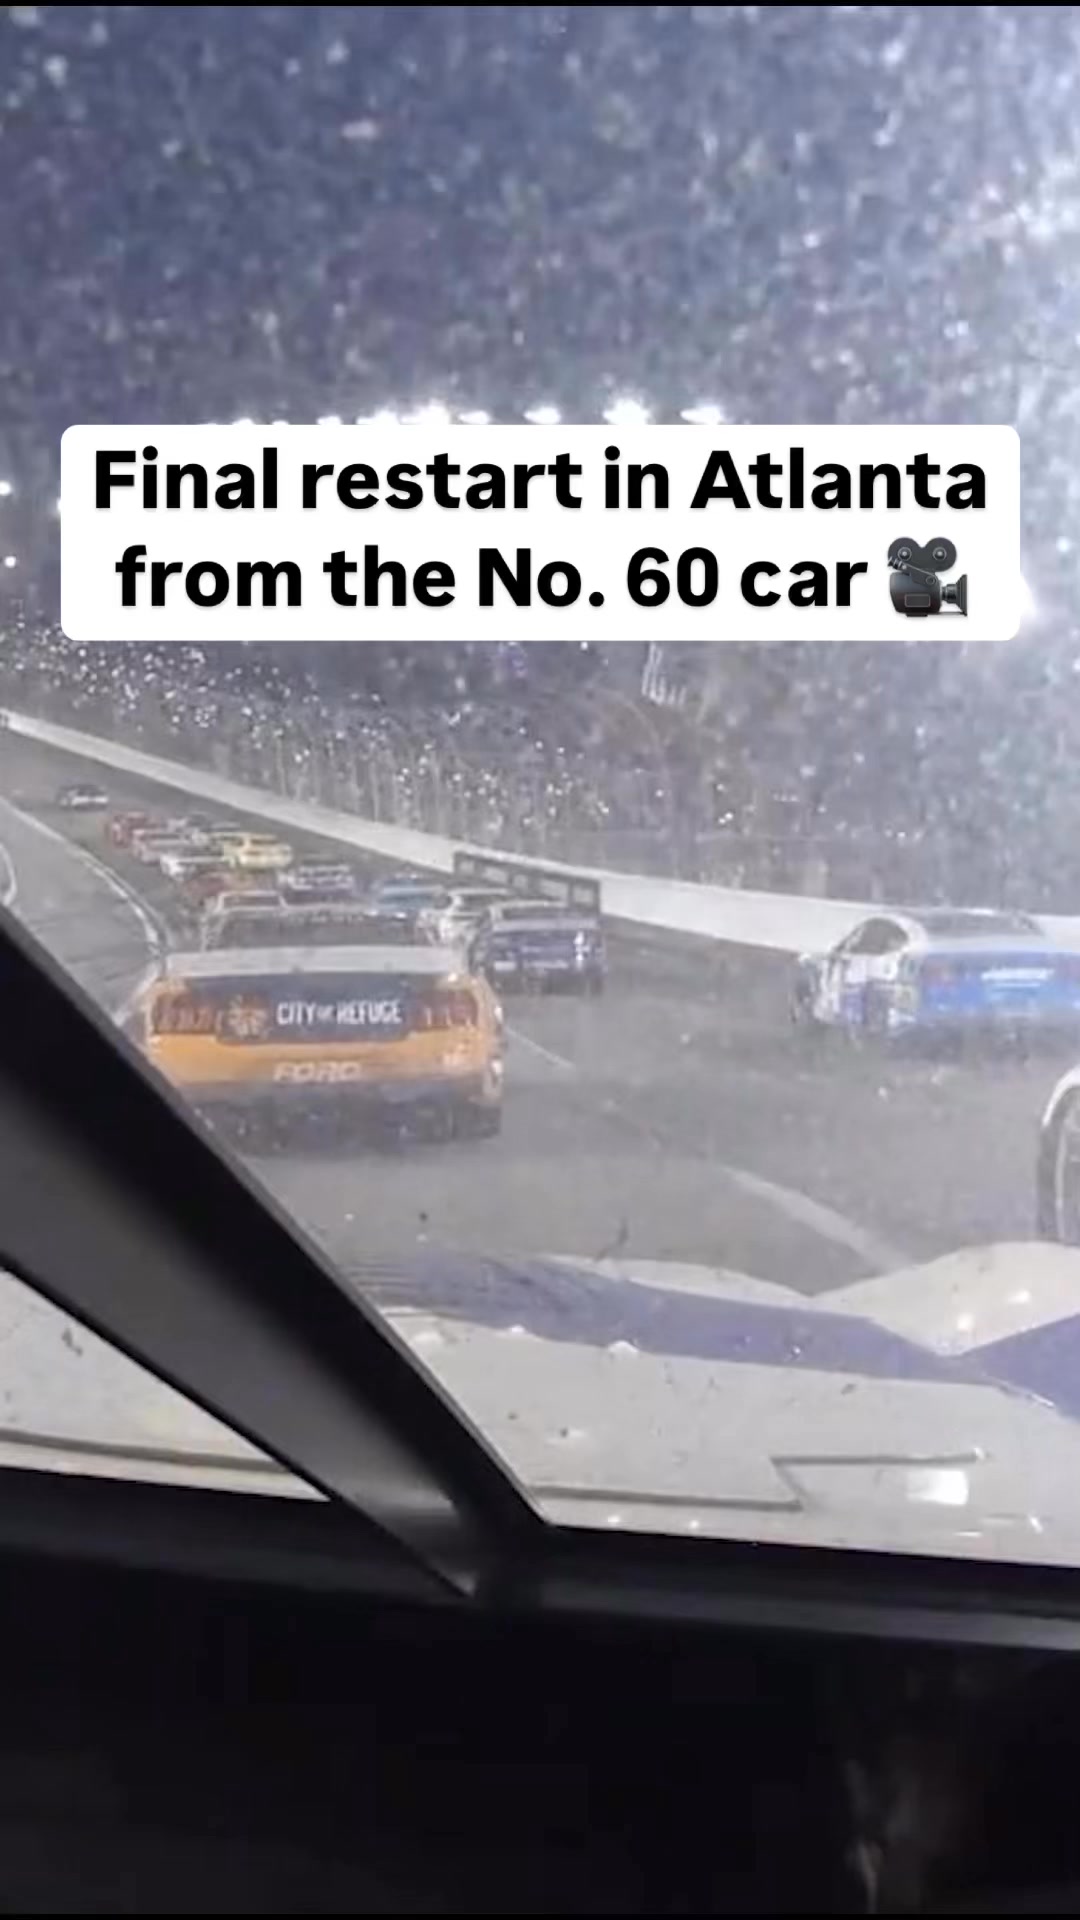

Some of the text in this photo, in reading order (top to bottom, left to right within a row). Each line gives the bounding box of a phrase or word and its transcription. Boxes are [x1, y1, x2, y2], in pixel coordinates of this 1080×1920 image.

[277, 1001, 316, 1025] CITY
[336, 999, 402, 1025] REFUGE
[272, 1061, 362, 1082] FORD
